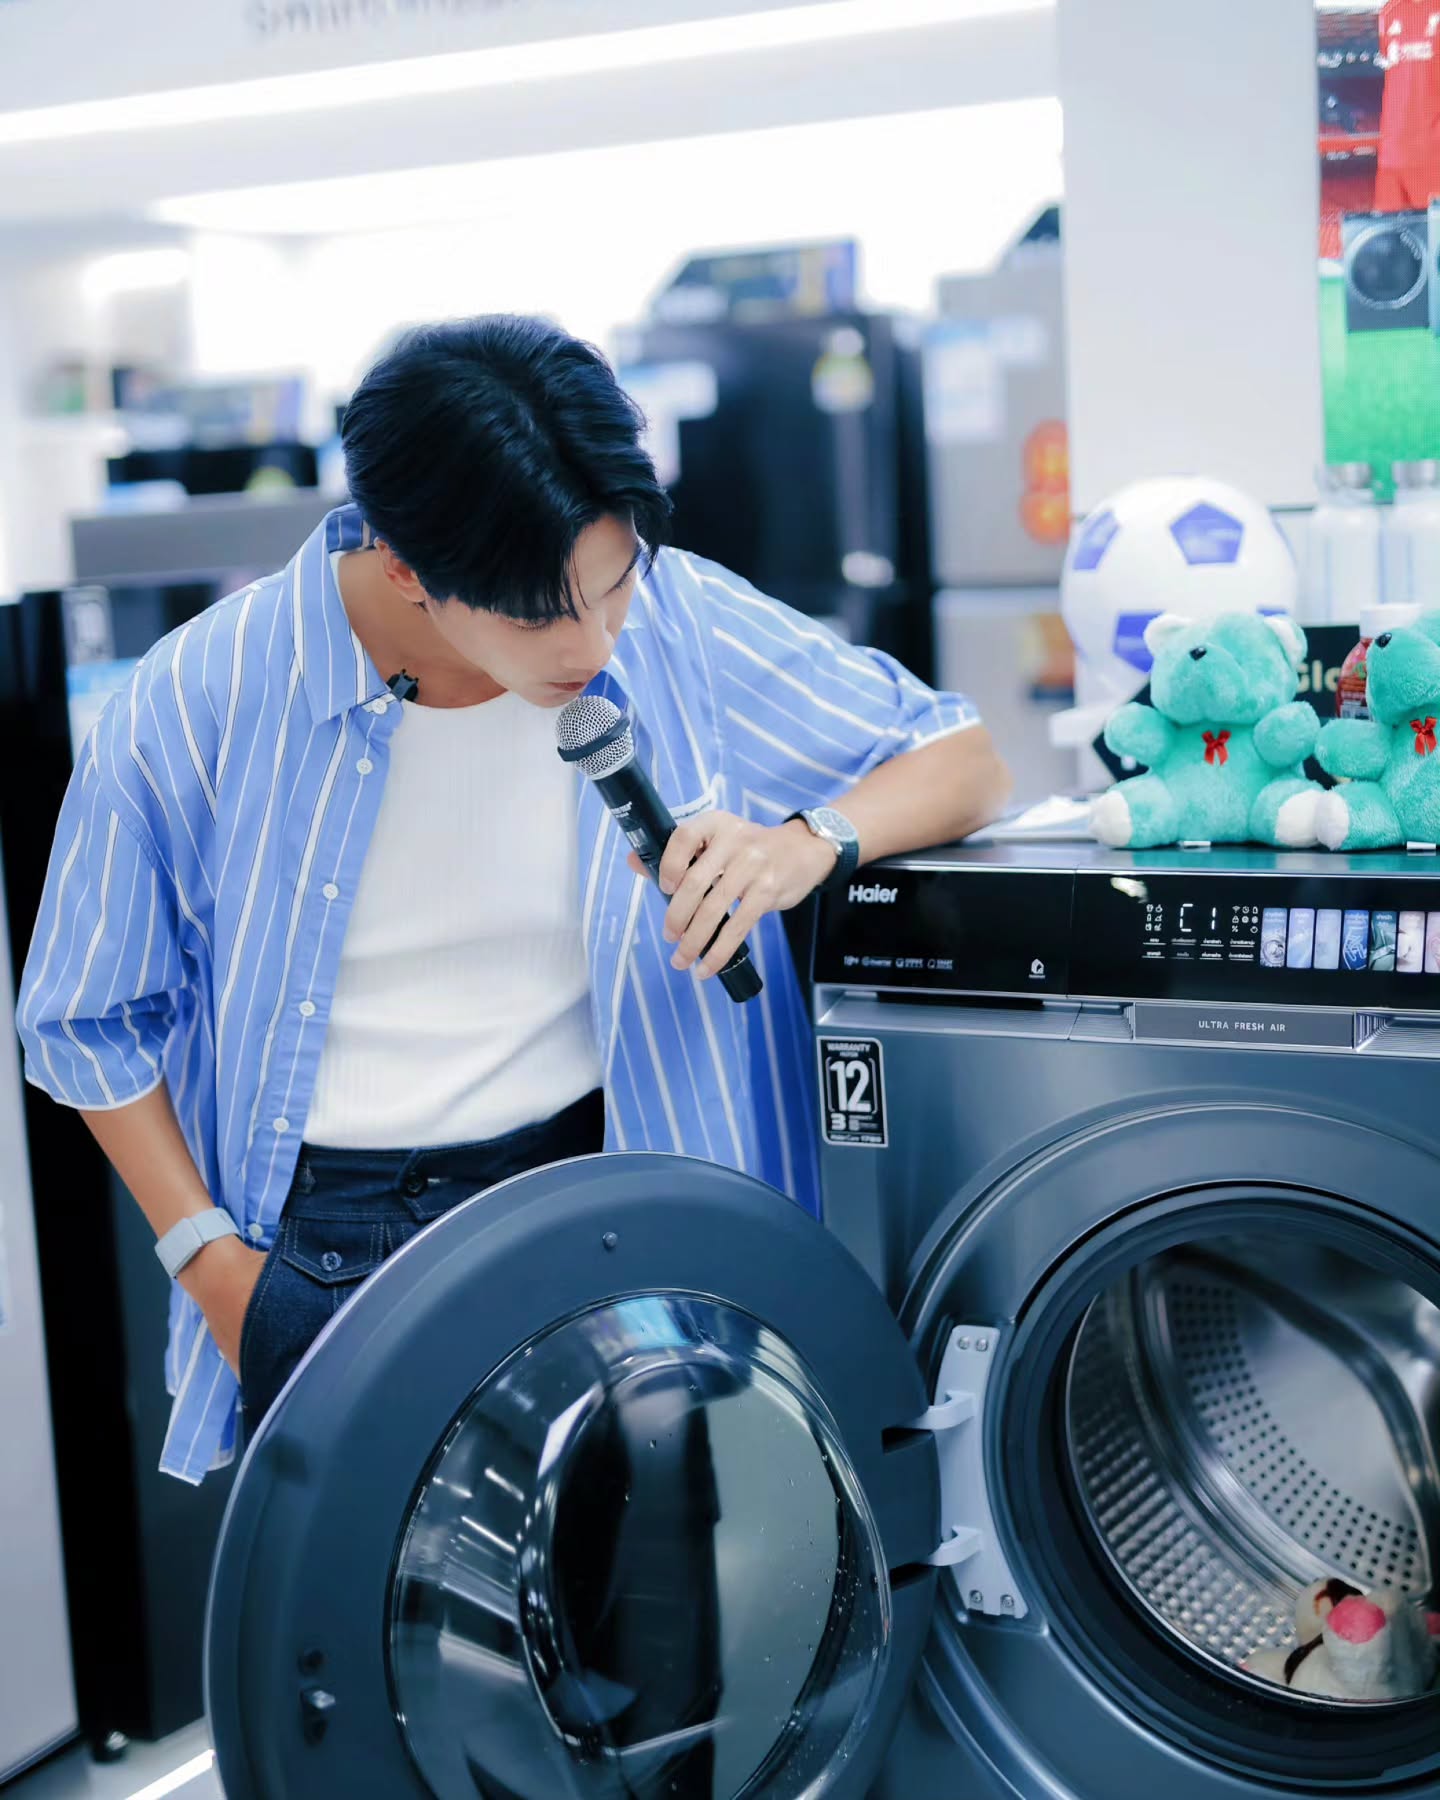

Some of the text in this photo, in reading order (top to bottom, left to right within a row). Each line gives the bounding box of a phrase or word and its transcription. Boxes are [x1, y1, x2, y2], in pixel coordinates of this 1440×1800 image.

[848, 883, 898, 903] Haier
[1198, 1020, 1286, 1032] ULTRA FRESH AIR
[829, 1059, 872, 1113] 12
[830, 1112, 847, 1131] 3
